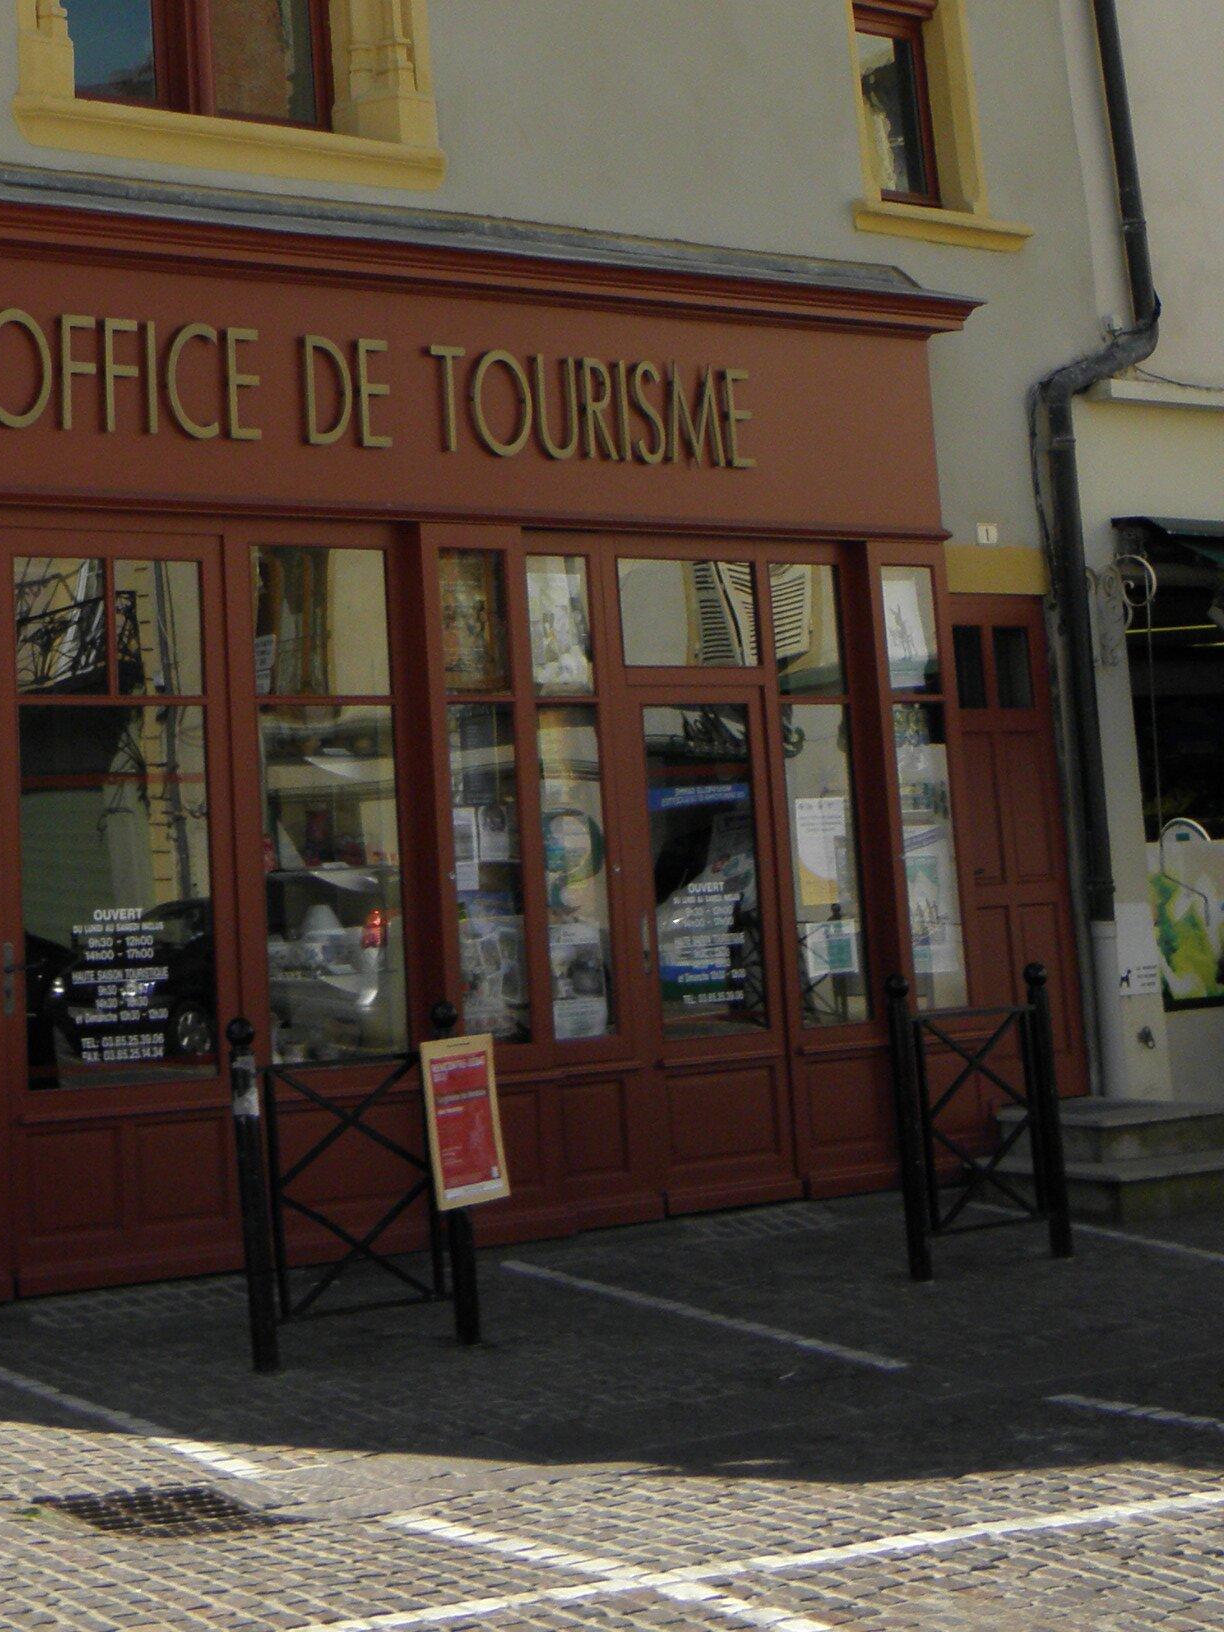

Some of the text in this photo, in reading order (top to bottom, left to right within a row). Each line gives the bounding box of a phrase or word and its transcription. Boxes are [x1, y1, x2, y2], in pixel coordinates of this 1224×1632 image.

[302, 334, 392, 447] DE
[430, 345, 757, 468] TOURISME
[687, 881, 725, 894] OUVERT
[93, 908, 143, 921] OUVERT
